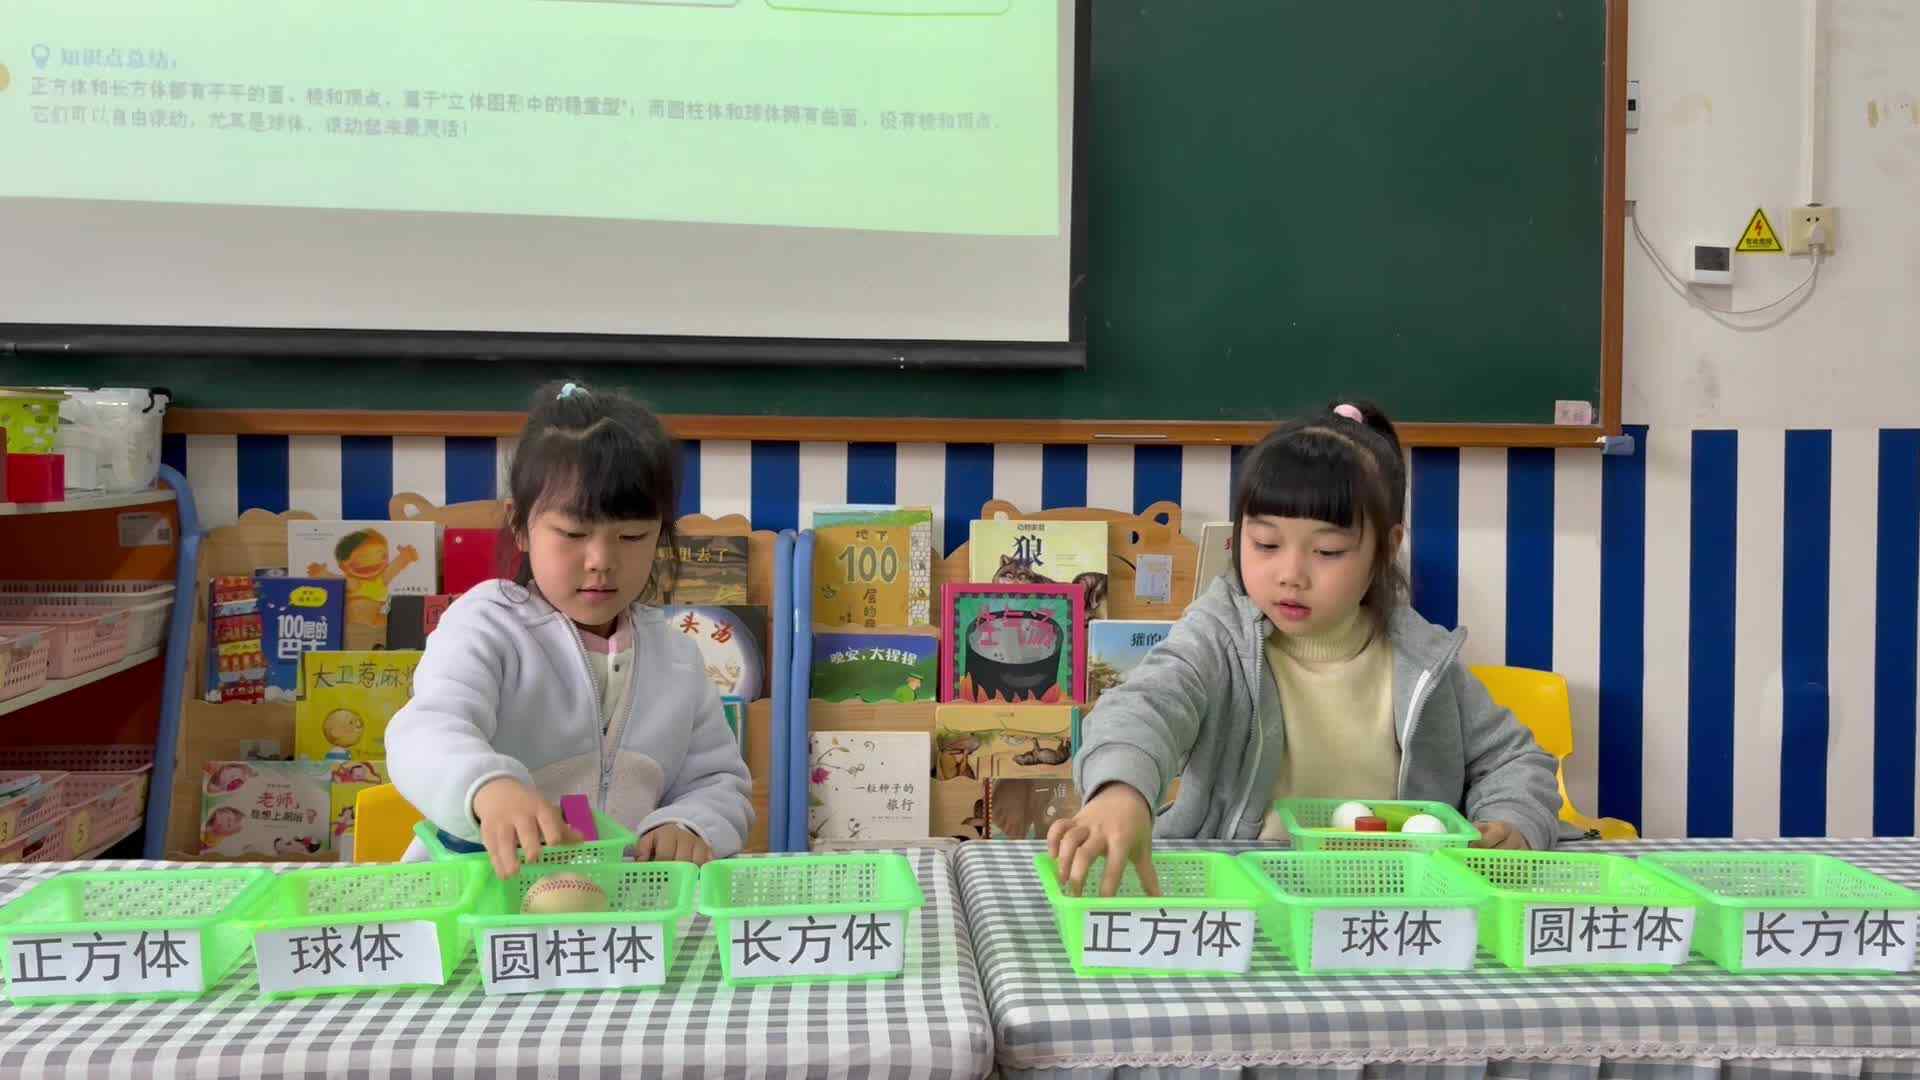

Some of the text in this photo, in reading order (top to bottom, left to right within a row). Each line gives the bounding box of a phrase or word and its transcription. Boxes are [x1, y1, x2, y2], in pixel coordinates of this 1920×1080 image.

[856, 529, 888, 542] 地下
[1013, 534, 1044, 568] 狼
[838, 546, 898, 583] 100
[277, 614, 328, 640] 100层的
[887, 798, 915, 811] 旅行
[289, 922, 404, 975] 球体
[489, 925, 656, 983] 圆柱体
[732, 913, 893, 967] 长方体
[1084, 907, 1242, 958] 正方体
[1341, 909, 1442, 957] 球体
[1529, 906, 1684, 955] 圆柱体
[1746, 909, 1906, 958] 长方体
[11, 929, 189, 984] 正方体
